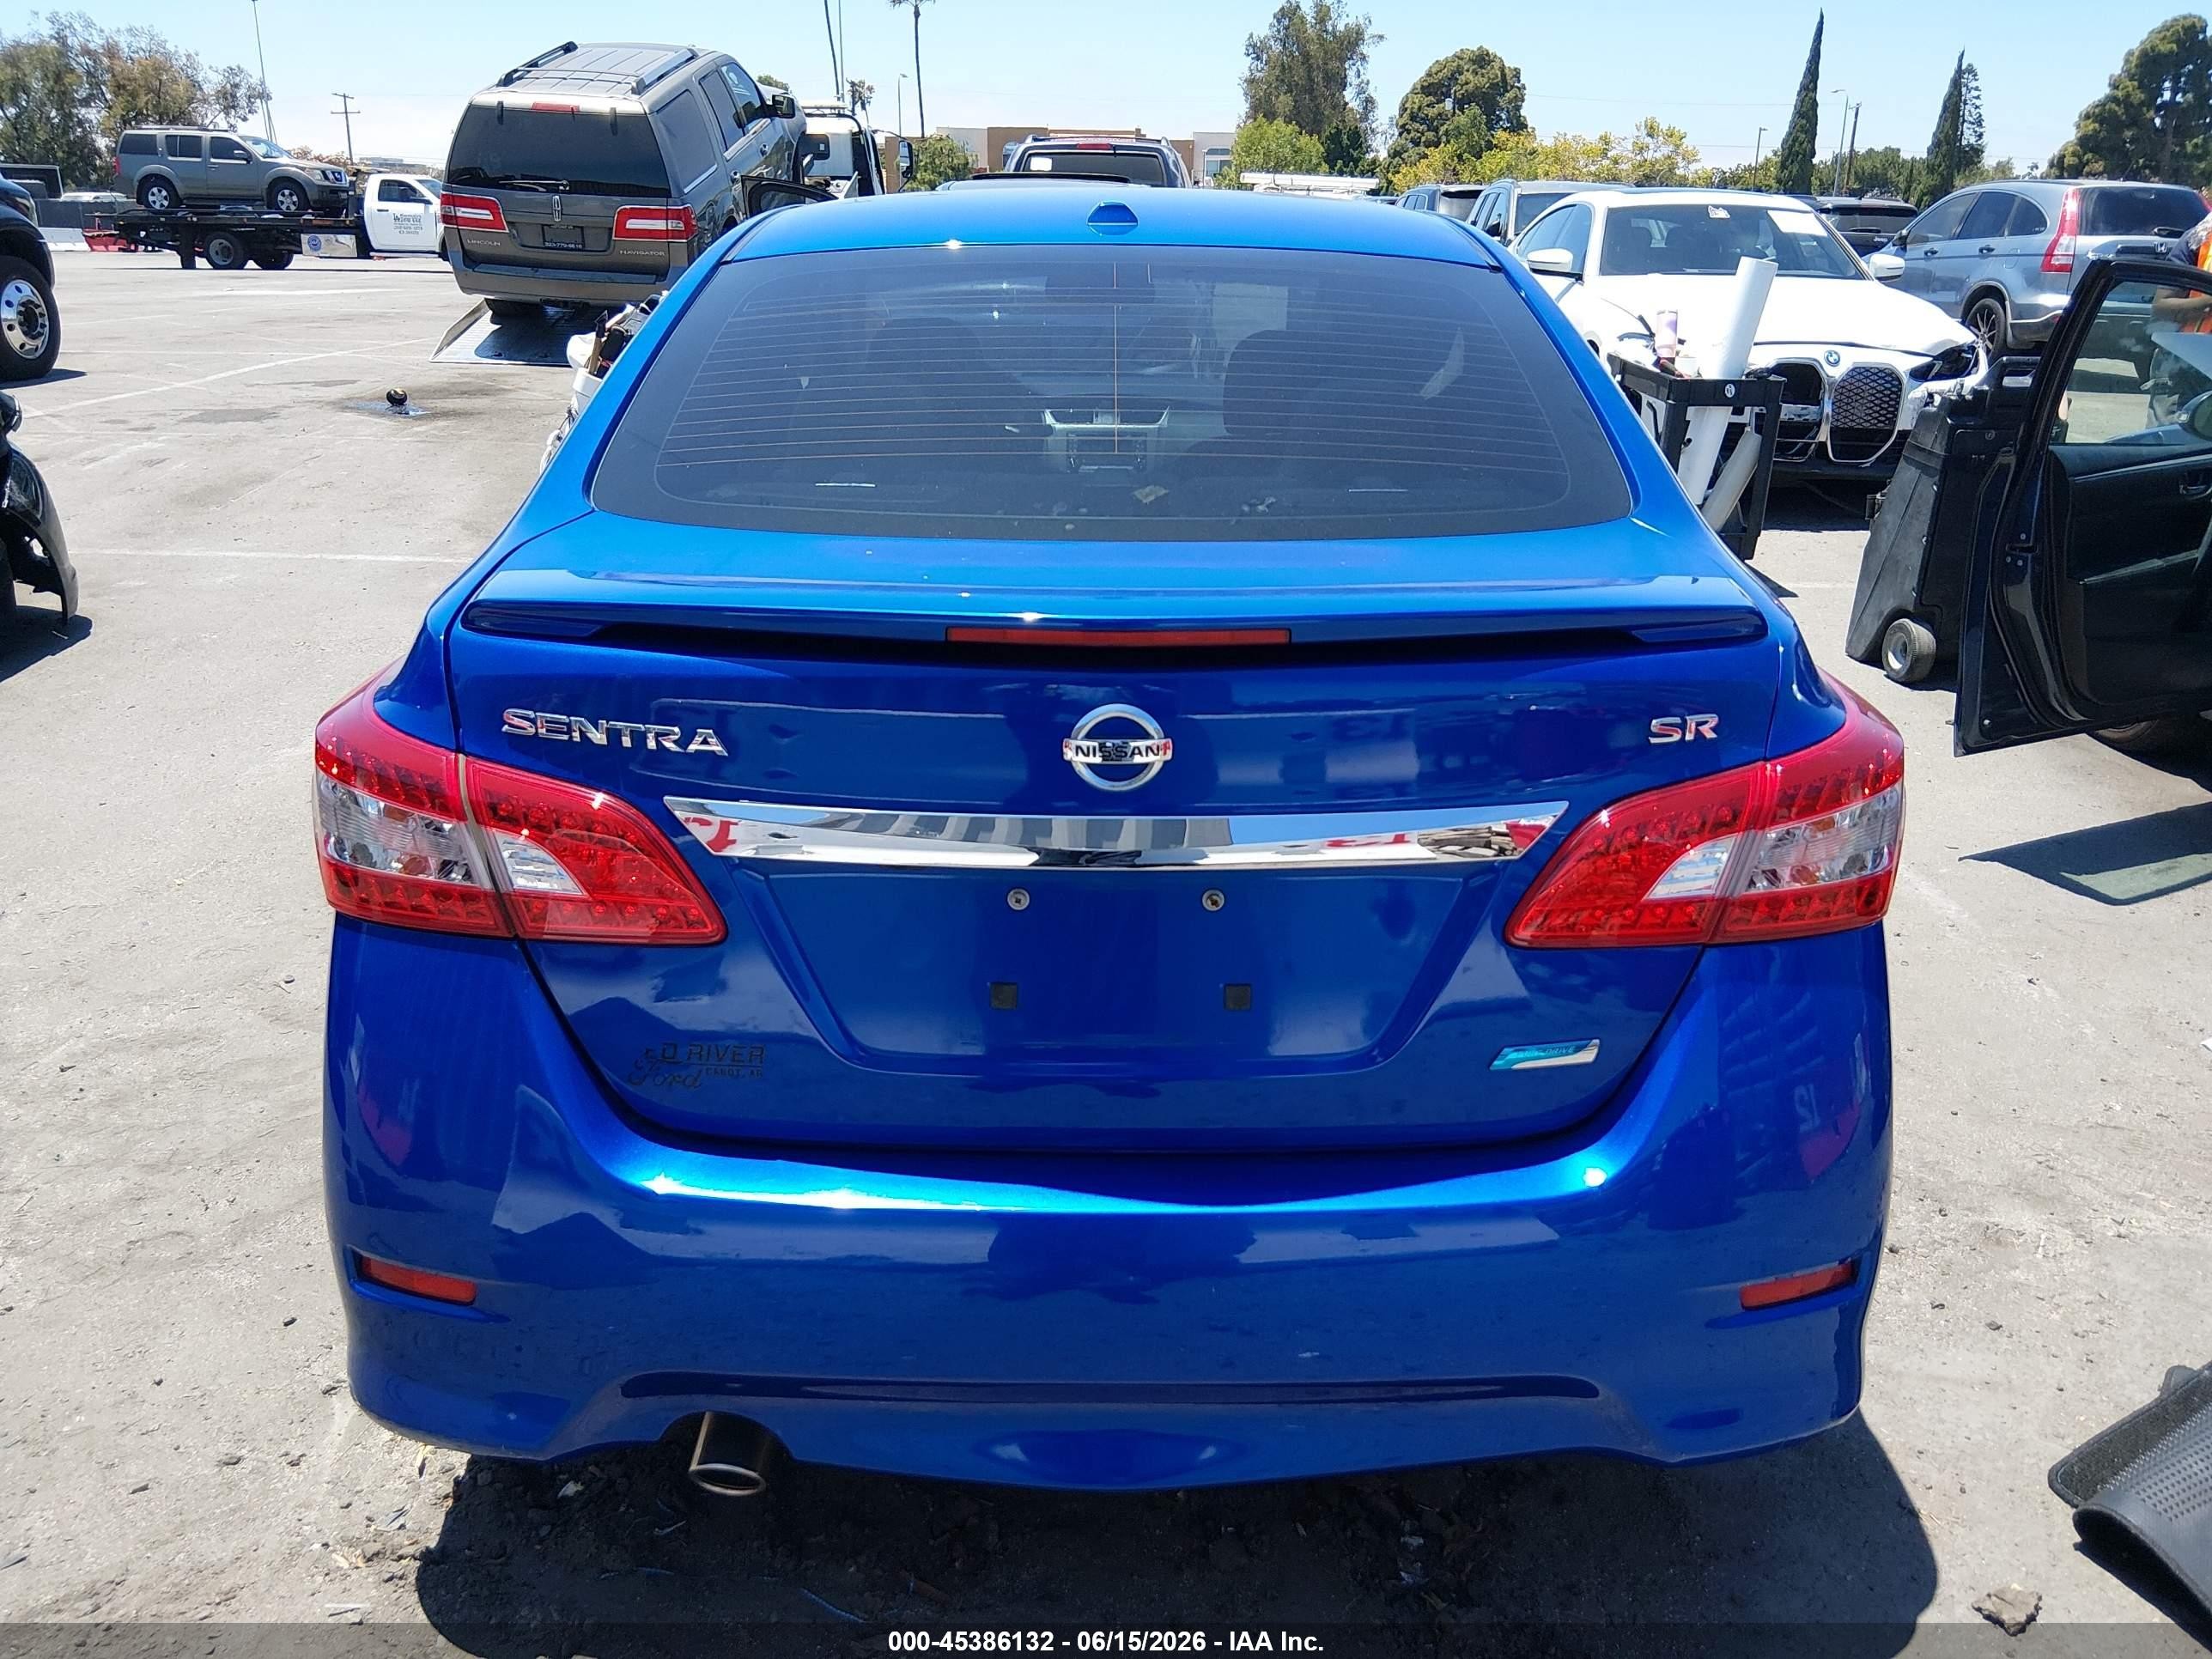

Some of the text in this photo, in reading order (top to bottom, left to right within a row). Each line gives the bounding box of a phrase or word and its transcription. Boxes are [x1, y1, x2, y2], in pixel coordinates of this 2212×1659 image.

[501, 708, 728, 757] SENTRA
[1649, 714, 1719, 744] SR
[1075, 743, 1160, 759] NISSAN
[687, 1043, 764, 1063] RIVER
[1546, 1045, 1576, 1055] DRIVE
